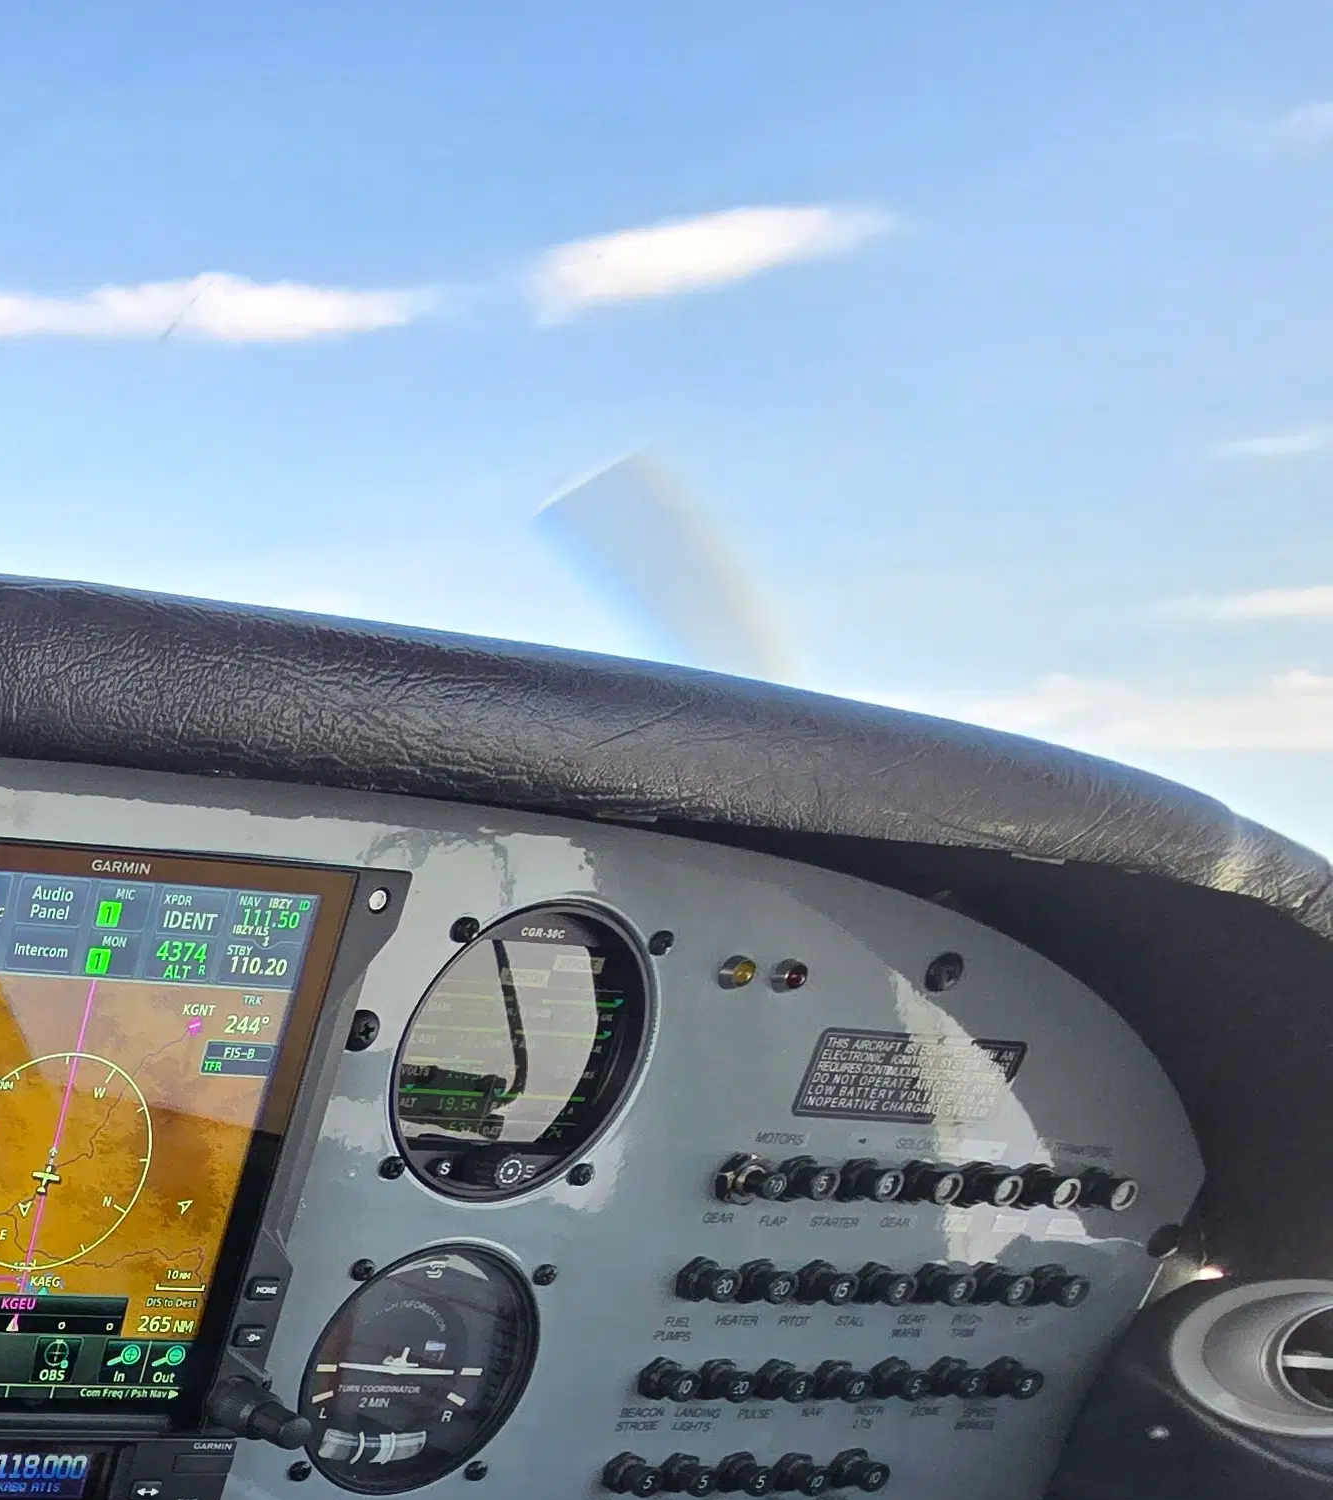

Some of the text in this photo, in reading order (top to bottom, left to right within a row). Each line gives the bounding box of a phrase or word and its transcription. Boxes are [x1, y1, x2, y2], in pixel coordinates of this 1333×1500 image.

[91, 859, 151, 875] GARMIN
[33, 885, 74, 902] Audio
[164, 894, 193, 906] XPDR
[30, 904, 70, 921] Panel
[242, 909, 299, 929] 111.50
[163, 911, 217, 932] IDENT
[520, 927, 566, 940] CGR-30C
[14, 943, 68, 959] Intercom
[156, 941, 207, 963] 4374
[163, 964, 191, 980] ALT
[230, 956, 287, 976] 110.20
[183, 1004, 216, 1018] KGNT
[803, 1097, 937, 1114] INOPERATIVE CHARGING
[756, 1131, 805, 1144] MOTORS
[759, 1214, 787, 1228] FLAP
[810, 1216, 859, 1229] STARTER
[1, 1297, 36, 1311] KGEU
[39, 1369, 65, 1382] OBS
[152, 1371, 175, 1383] Out
[338, 1383, 421, 1395] TURN COORDINATOR
[31, 1481, 61, 1493] ATIS
